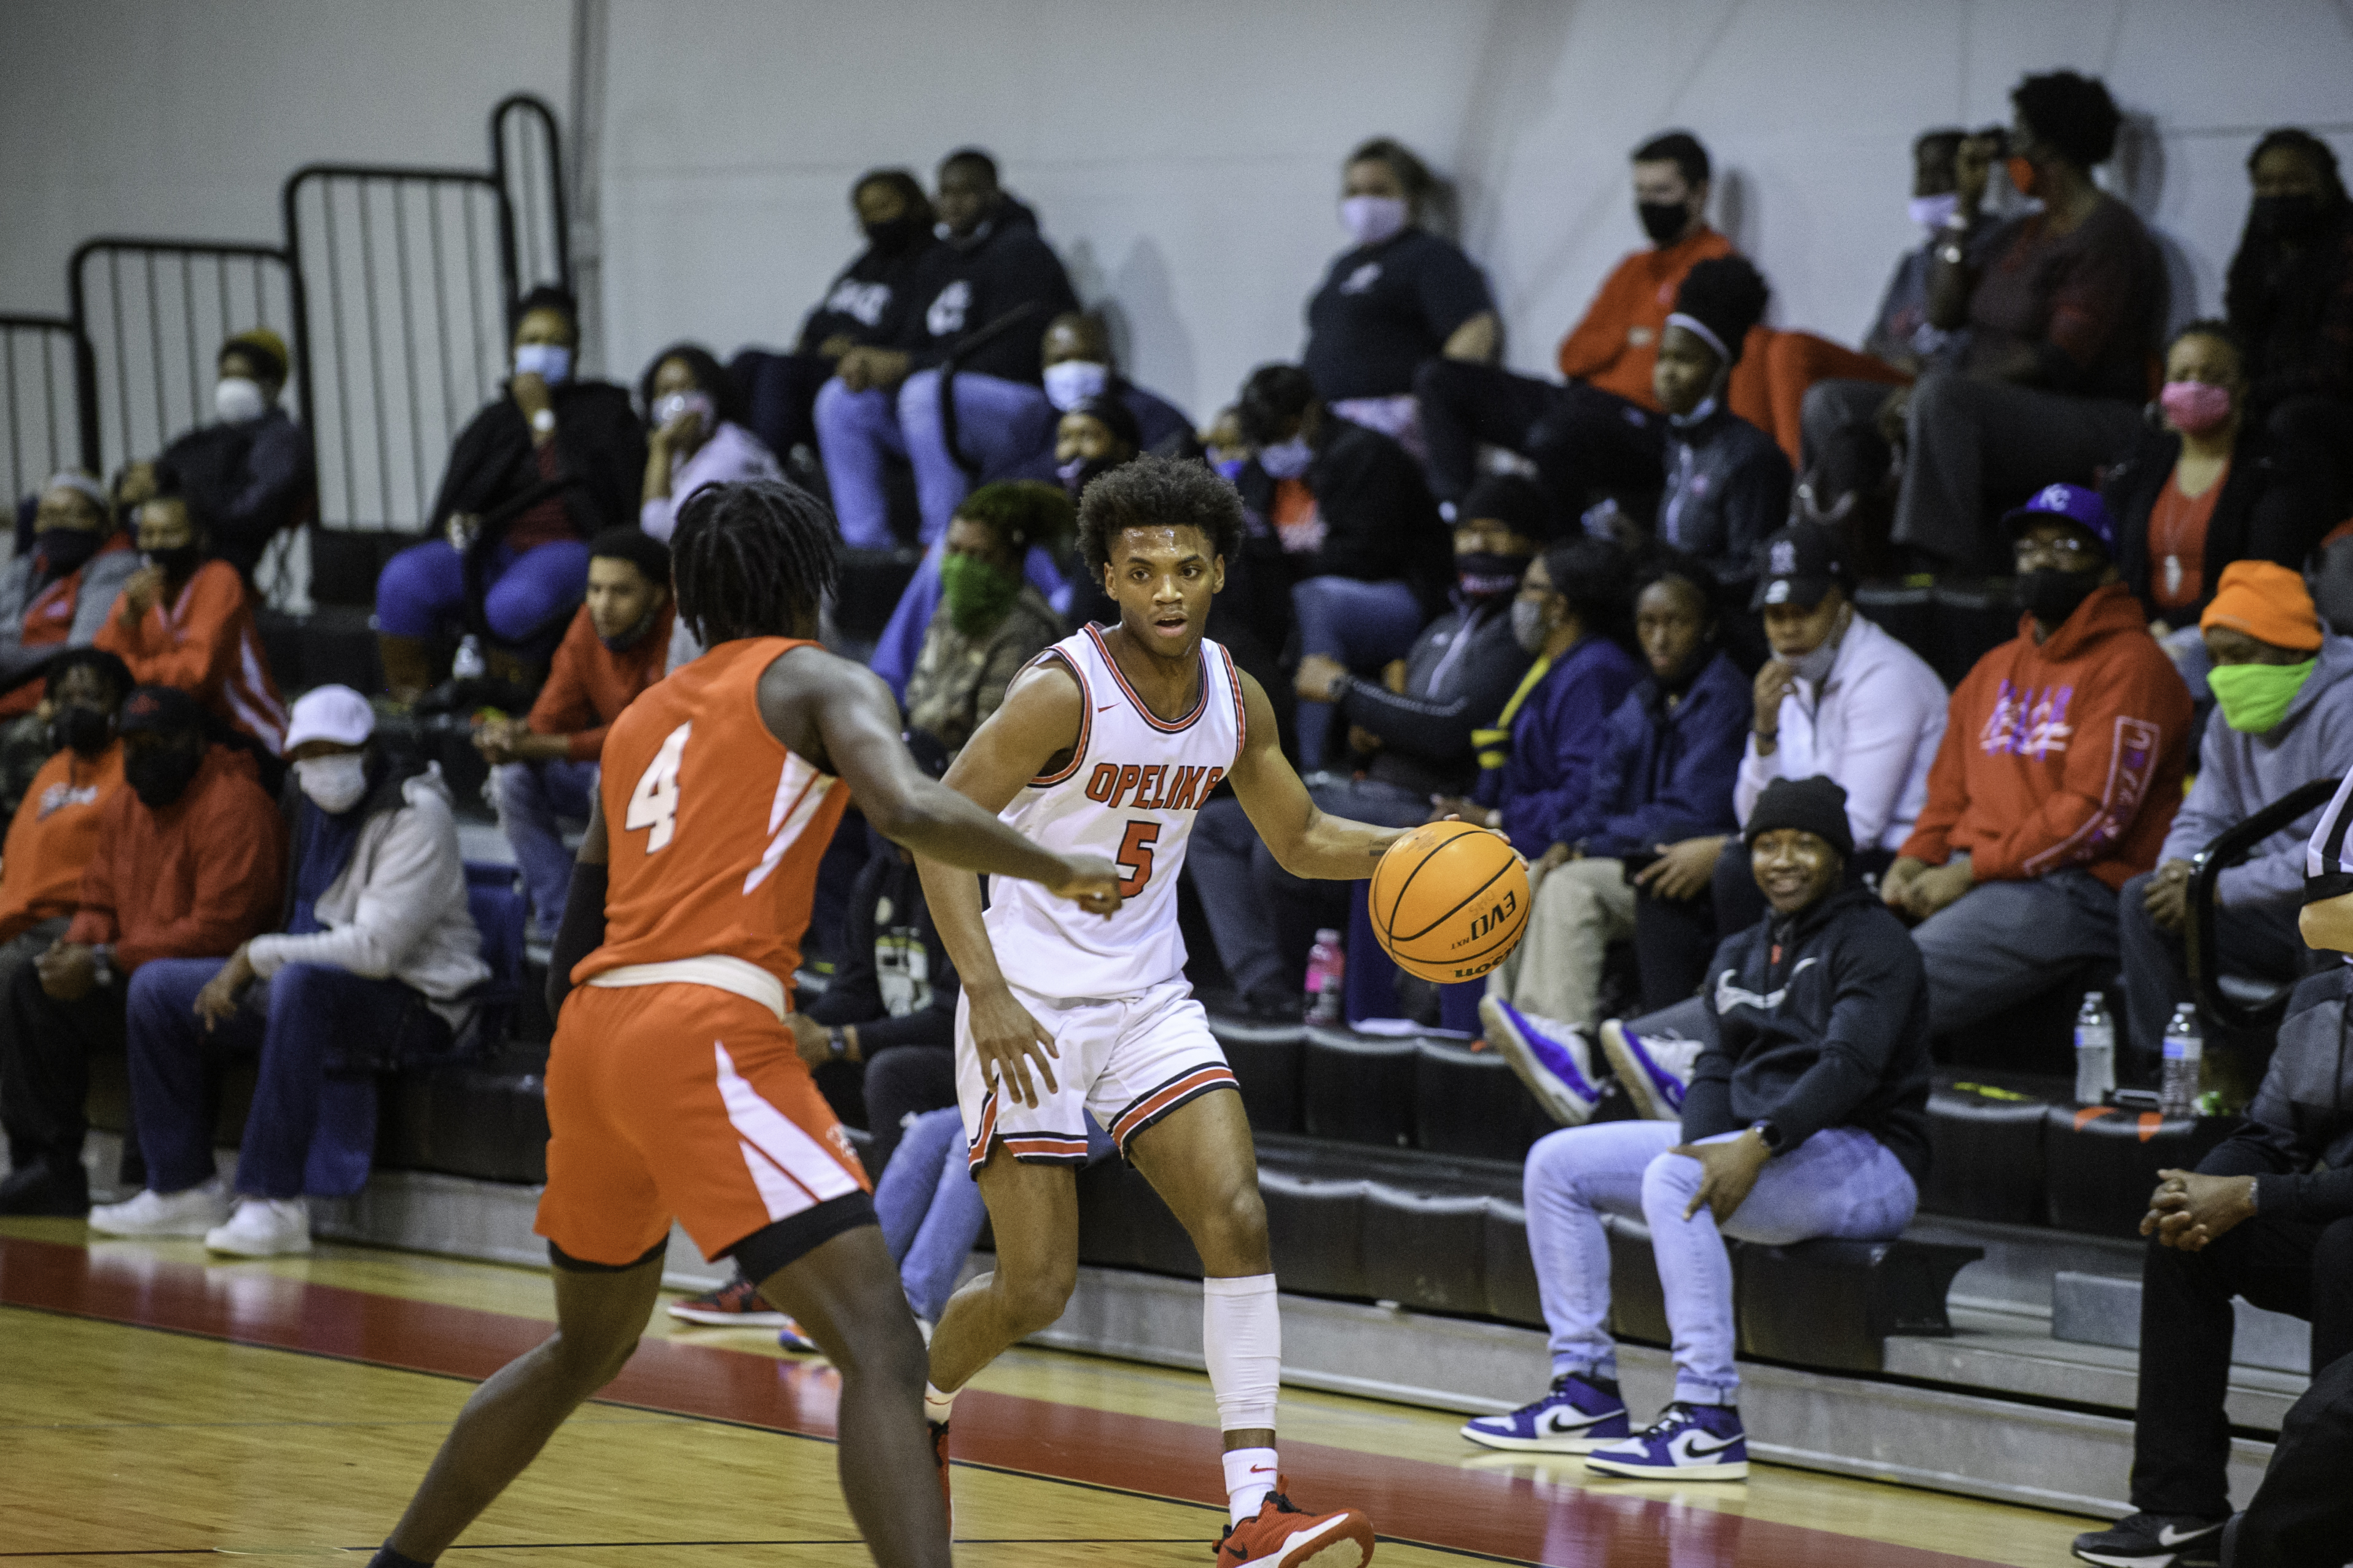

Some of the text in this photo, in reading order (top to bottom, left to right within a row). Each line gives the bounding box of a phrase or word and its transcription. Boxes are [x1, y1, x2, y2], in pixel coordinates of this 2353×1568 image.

[625, 719, 692, 854] 4
[1116, 820, 1161, 899] 5
[1451, 891, 1516, 950] EVO NXT
